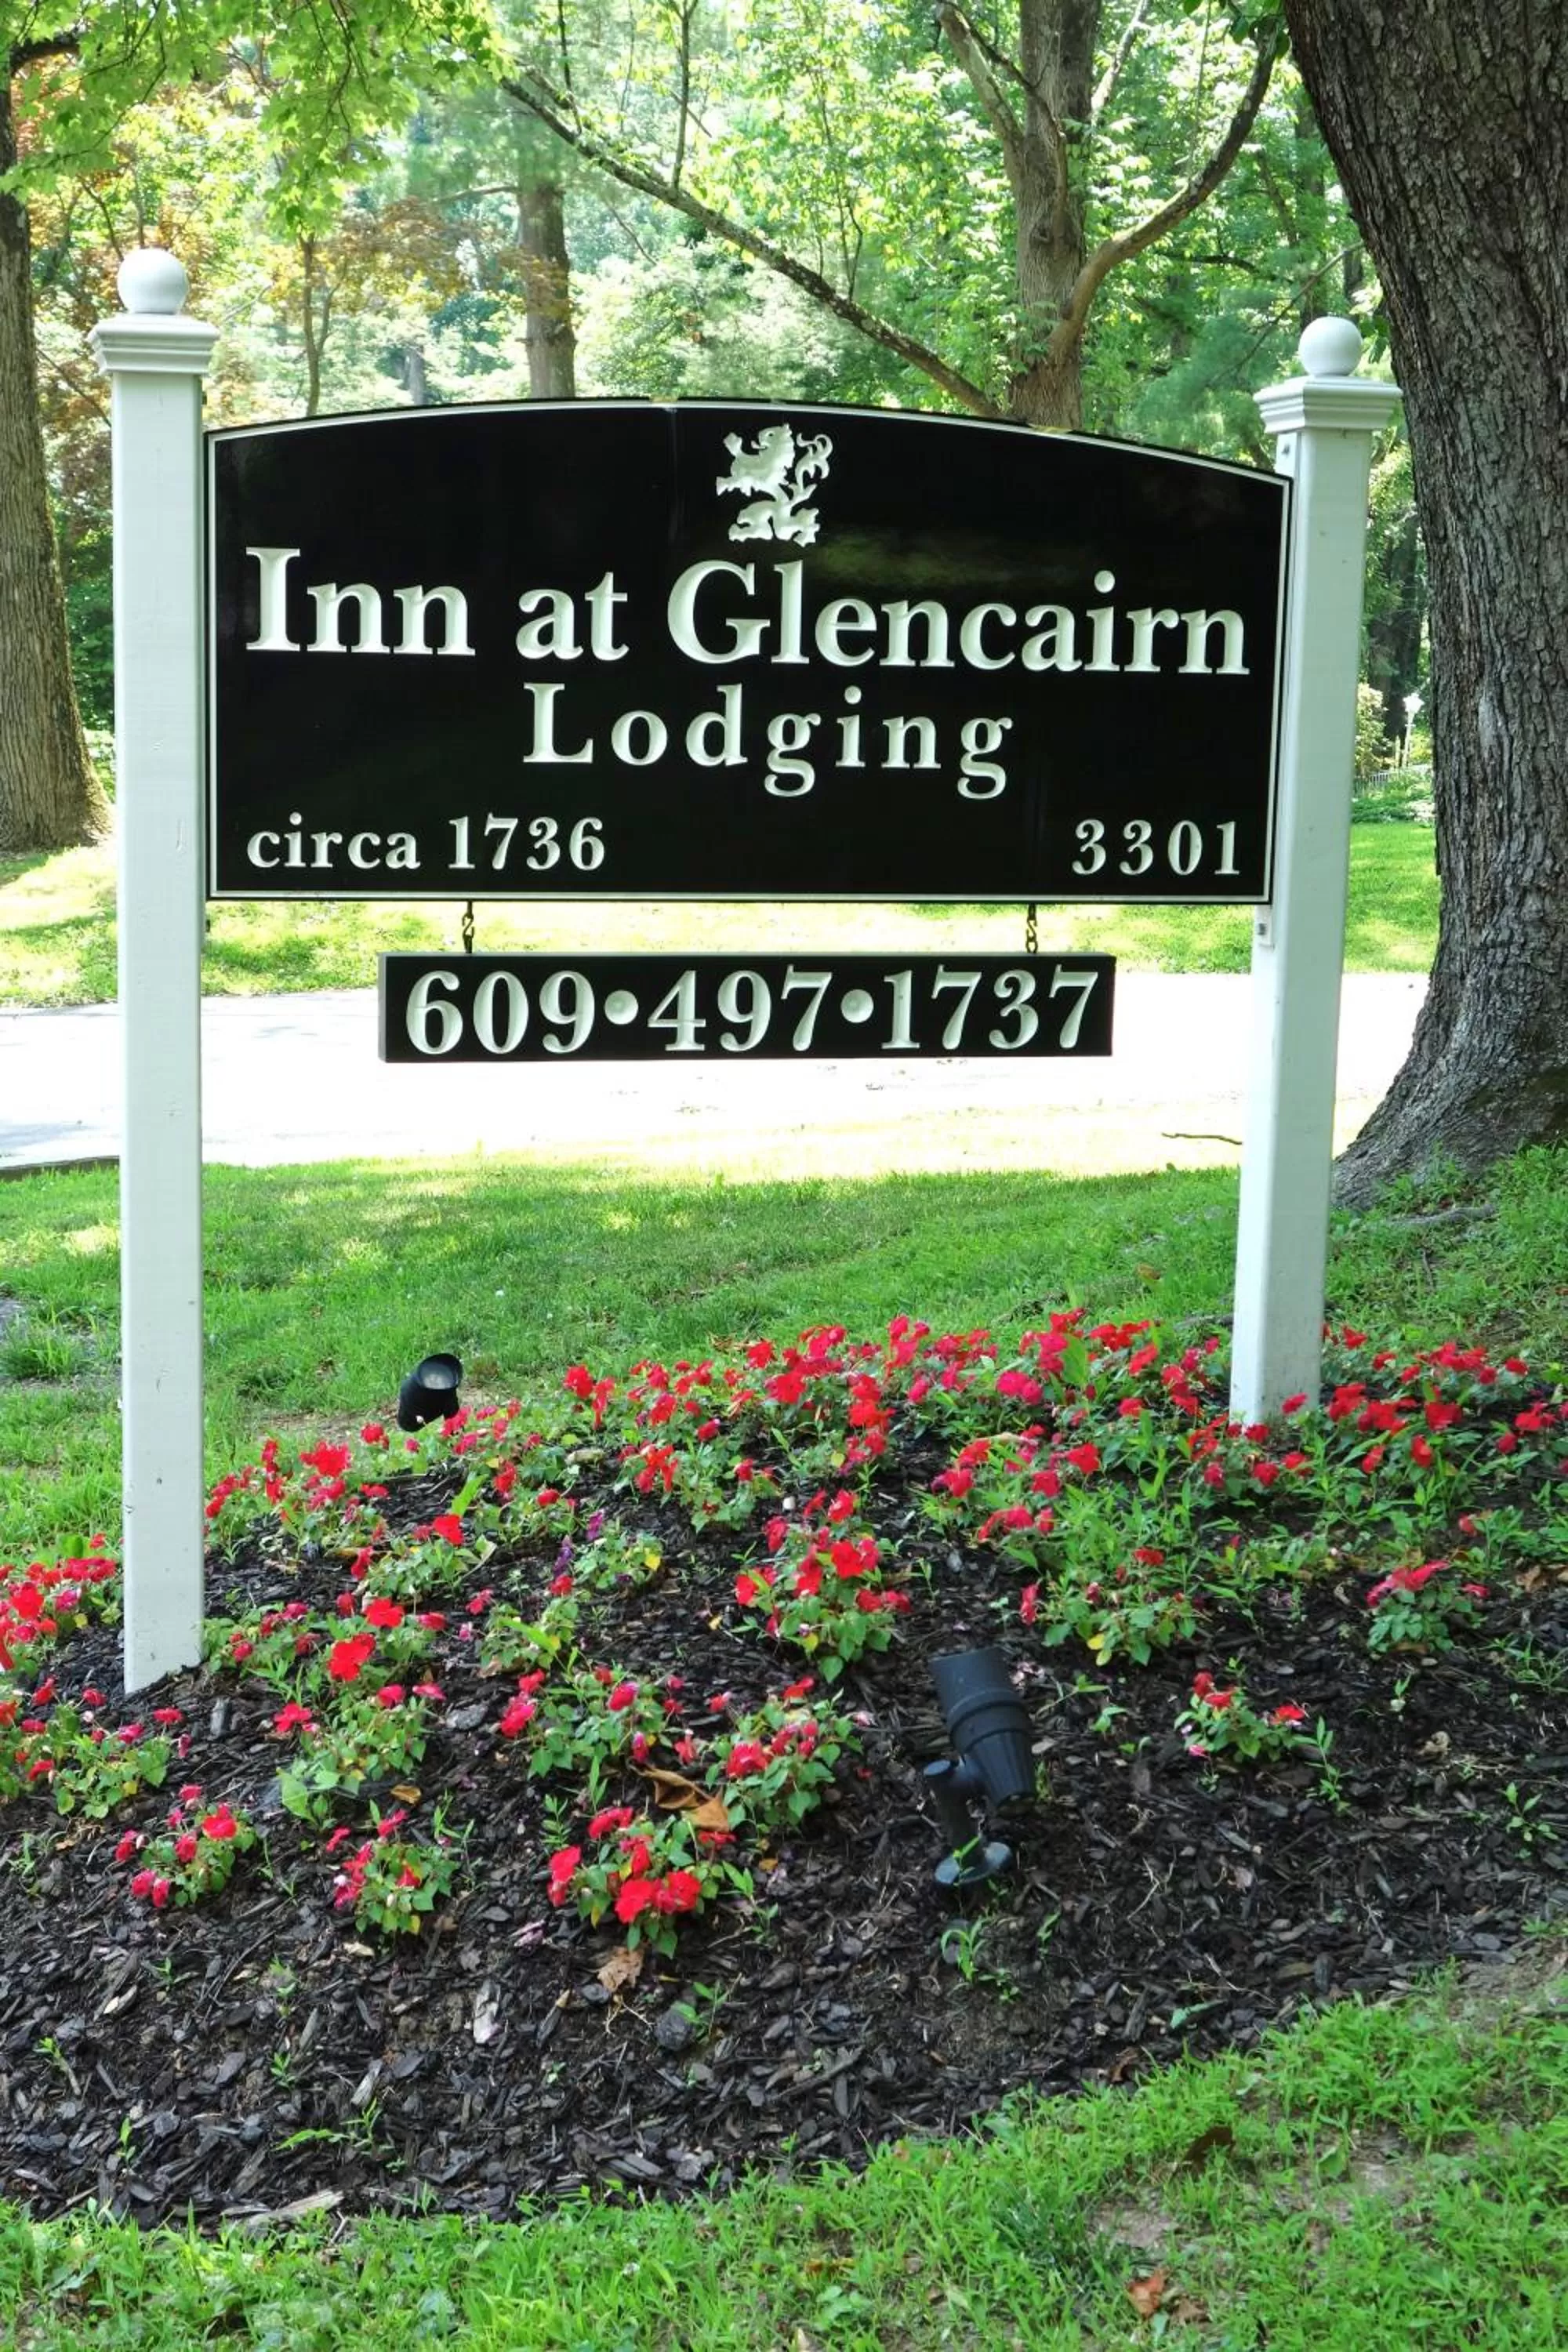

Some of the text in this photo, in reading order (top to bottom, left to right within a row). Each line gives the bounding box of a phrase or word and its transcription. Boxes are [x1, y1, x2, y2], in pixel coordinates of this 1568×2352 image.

[245, 546, 1250, 675] Inn at Glencairn
[523, 678, 1014, 800] Lodging
[247, 812, 605, 871] circa 1736
[1072, 819, 1240, 876] 3301
